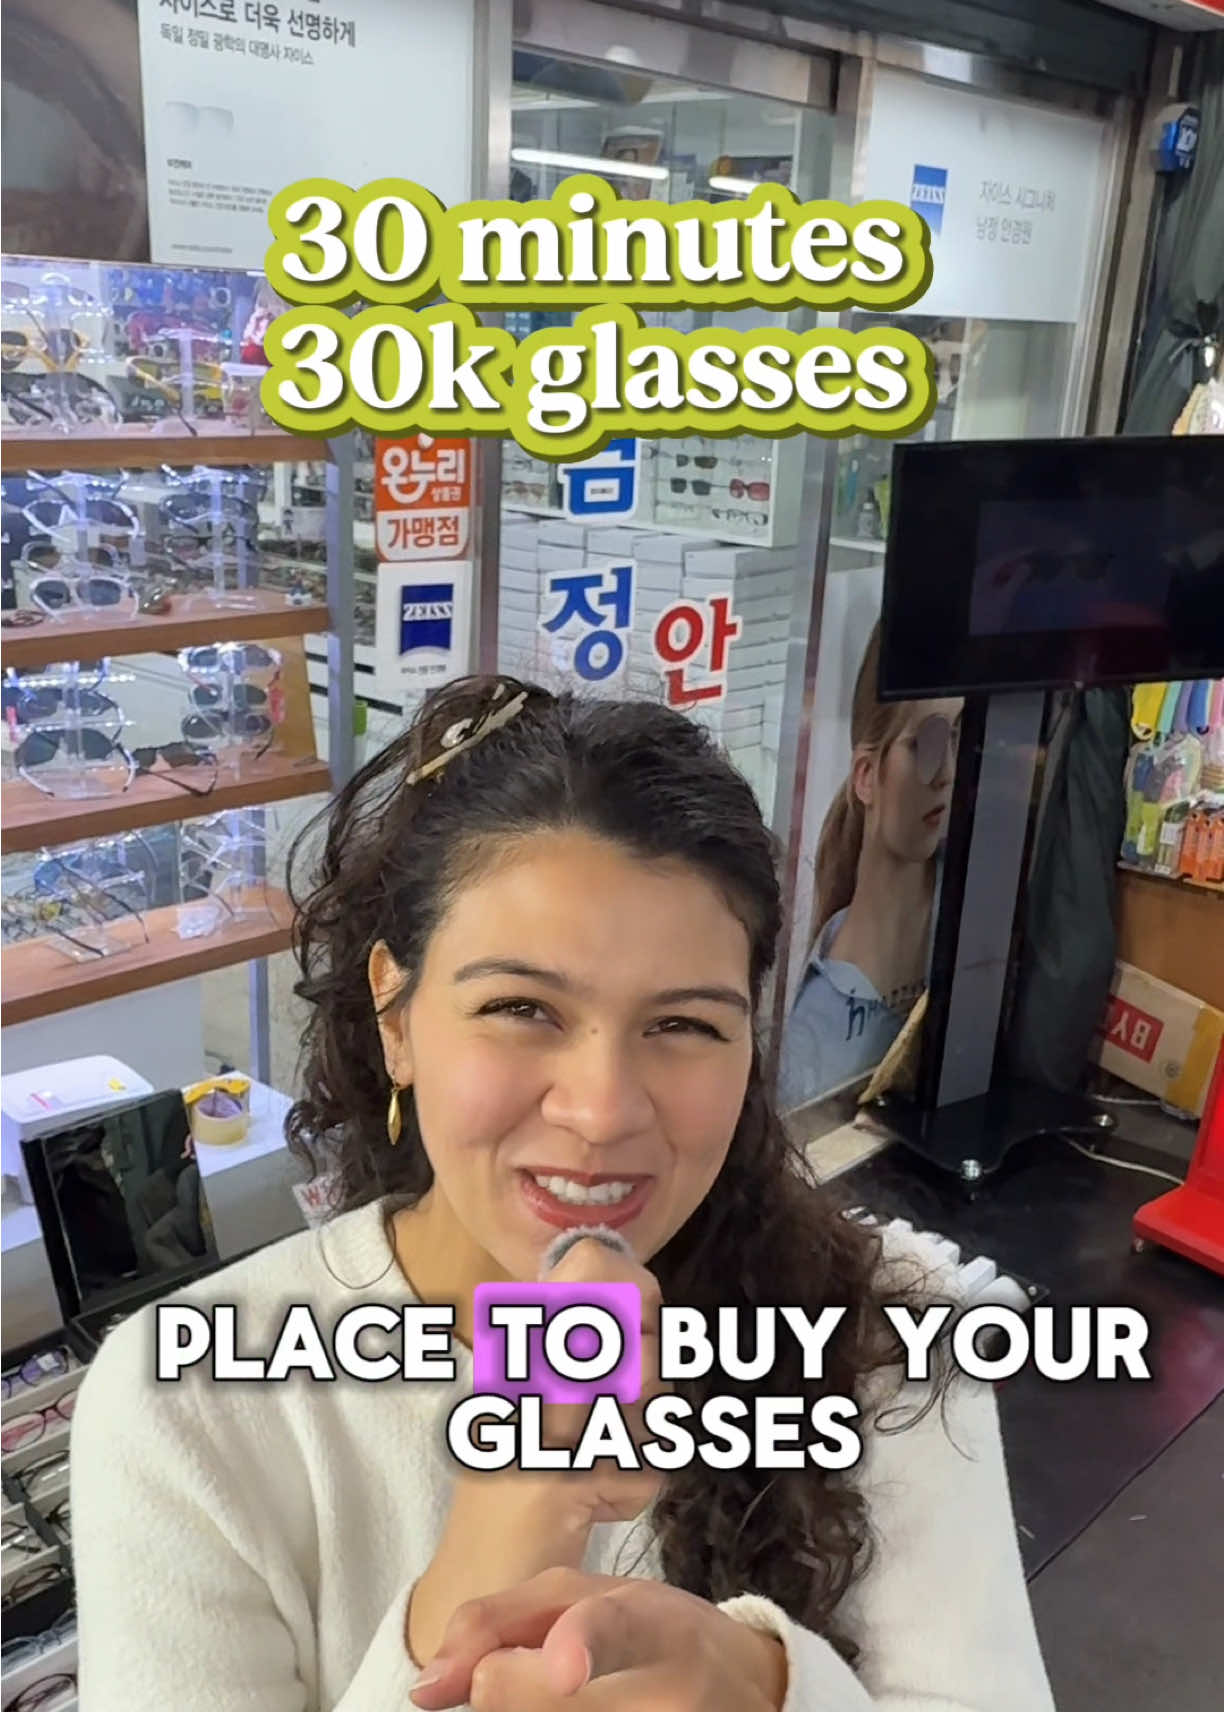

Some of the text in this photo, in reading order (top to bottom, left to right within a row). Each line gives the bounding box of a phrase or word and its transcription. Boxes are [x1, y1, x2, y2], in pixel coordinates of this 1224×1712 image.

[160, 23, 314, 65] 독일 정밀 광학의 대명사 자이스
[244, 2, 281, 32] 더욱
[287, 8, 356, 47] 선명하게
[979, 180, 1011, 205] 자이스
[381, 446, 465, 504] 온누리
[387, 515, 459, 549] 가맹점
[402, 601, 453, 621] ZEISS
[654, 598, 737, 705] 안
